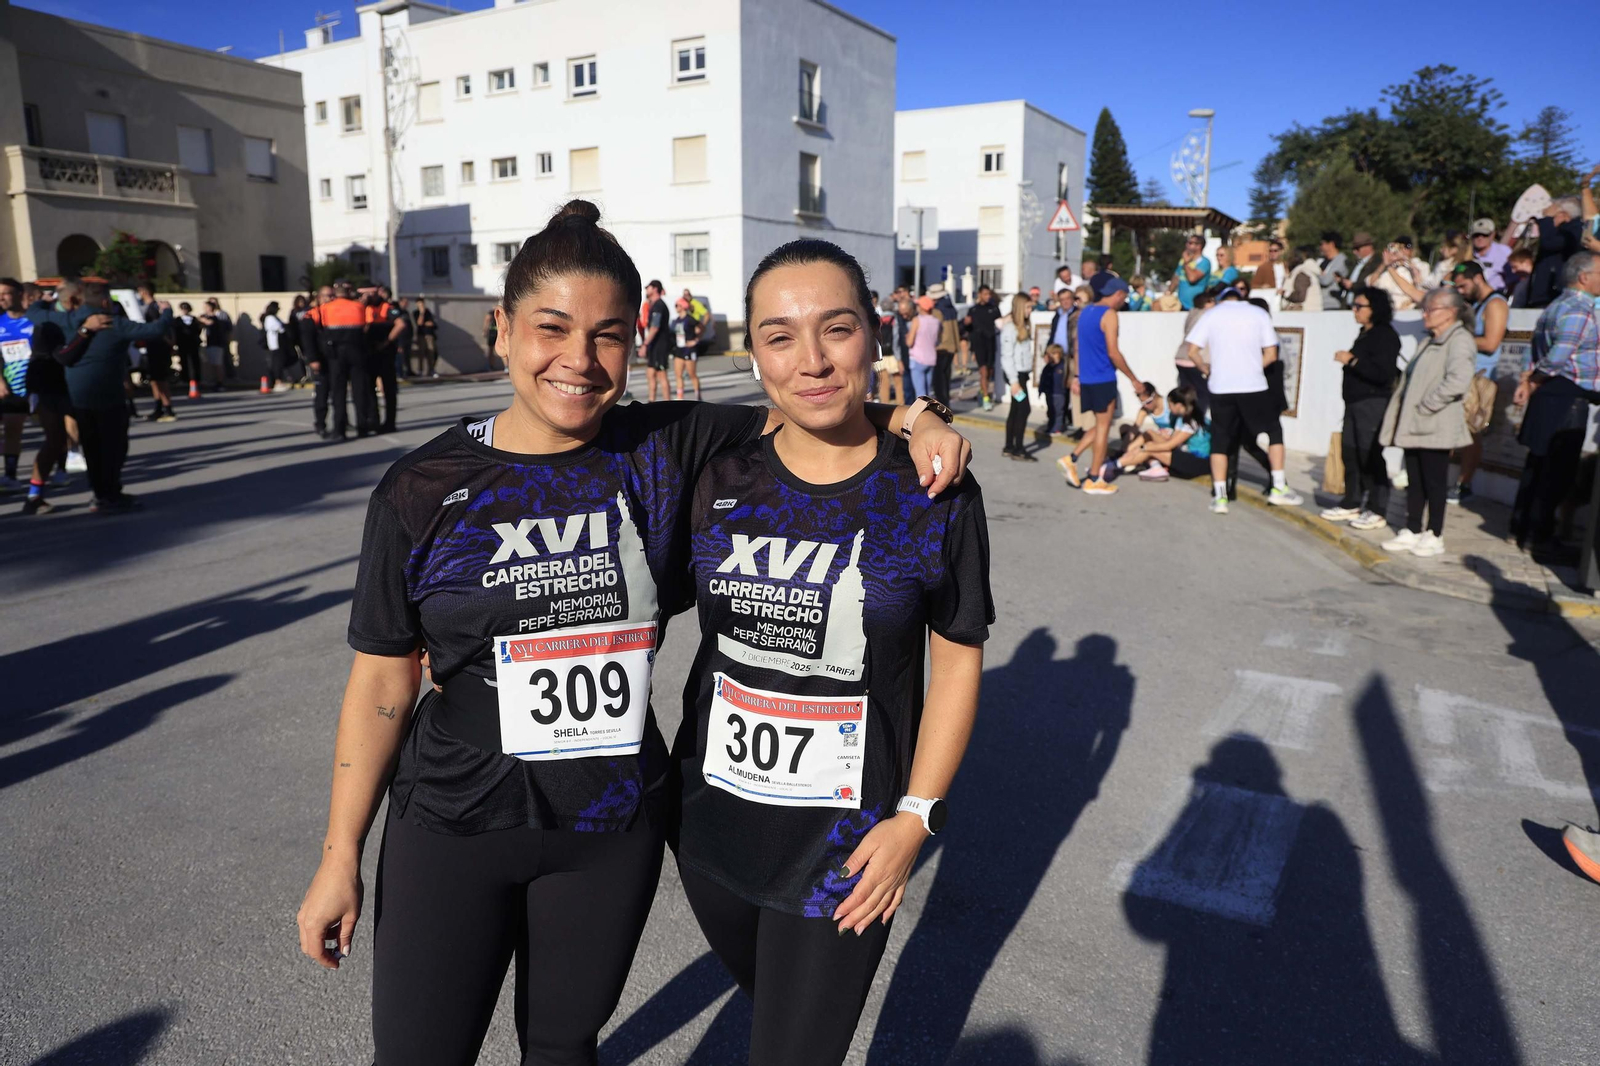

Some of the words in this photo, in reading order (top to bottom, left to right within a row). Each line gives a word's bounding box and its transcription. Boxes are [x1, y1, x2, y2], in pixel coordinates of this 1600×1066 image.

[489, 511, 609, 565] XVI
[482, 558, 578, 589] CARRERA
[579, 552, 616, 575] DEL
[716, 533, 839, 584] XVI
[515, 570, 618, 601] ESTRECHO
[708, 578, 787, 603] CARRERA
[788, 587, 824, 607] DEL
[550, 591, 621, 614] MEMORIAL
[731, 599, 824, 624] ESTRECHO
[518, 616, 555, 633] PEPE
[557, 605, 622, 626] SERRANO
[756, 621, 818, 643] MEMORIAL
[535, 637, 588, 653] CARRERA
[589, 635, 612, 647] DEL
[733, 626, 760, 644] PEPE
[759, 634, 817, 655] SERRANO
[747, 653, 791, 668] DICIEMBRE
[790, 661, 812, 672] 2025
[825, 664, 856, 676] TARIFA
[529, 661, 631, 726] 309
[734, 692, 778, 711] CARRERA
[778, 701, 800, 713] DEL
[801, 704, 861, 715] ESTRECHO
[553, 727, 589, 739] SHEILA
[725, 713, 815, 775] 307
[728, 764, 771, 785] ALMUDENA
[845, 762, 851, 770] S
